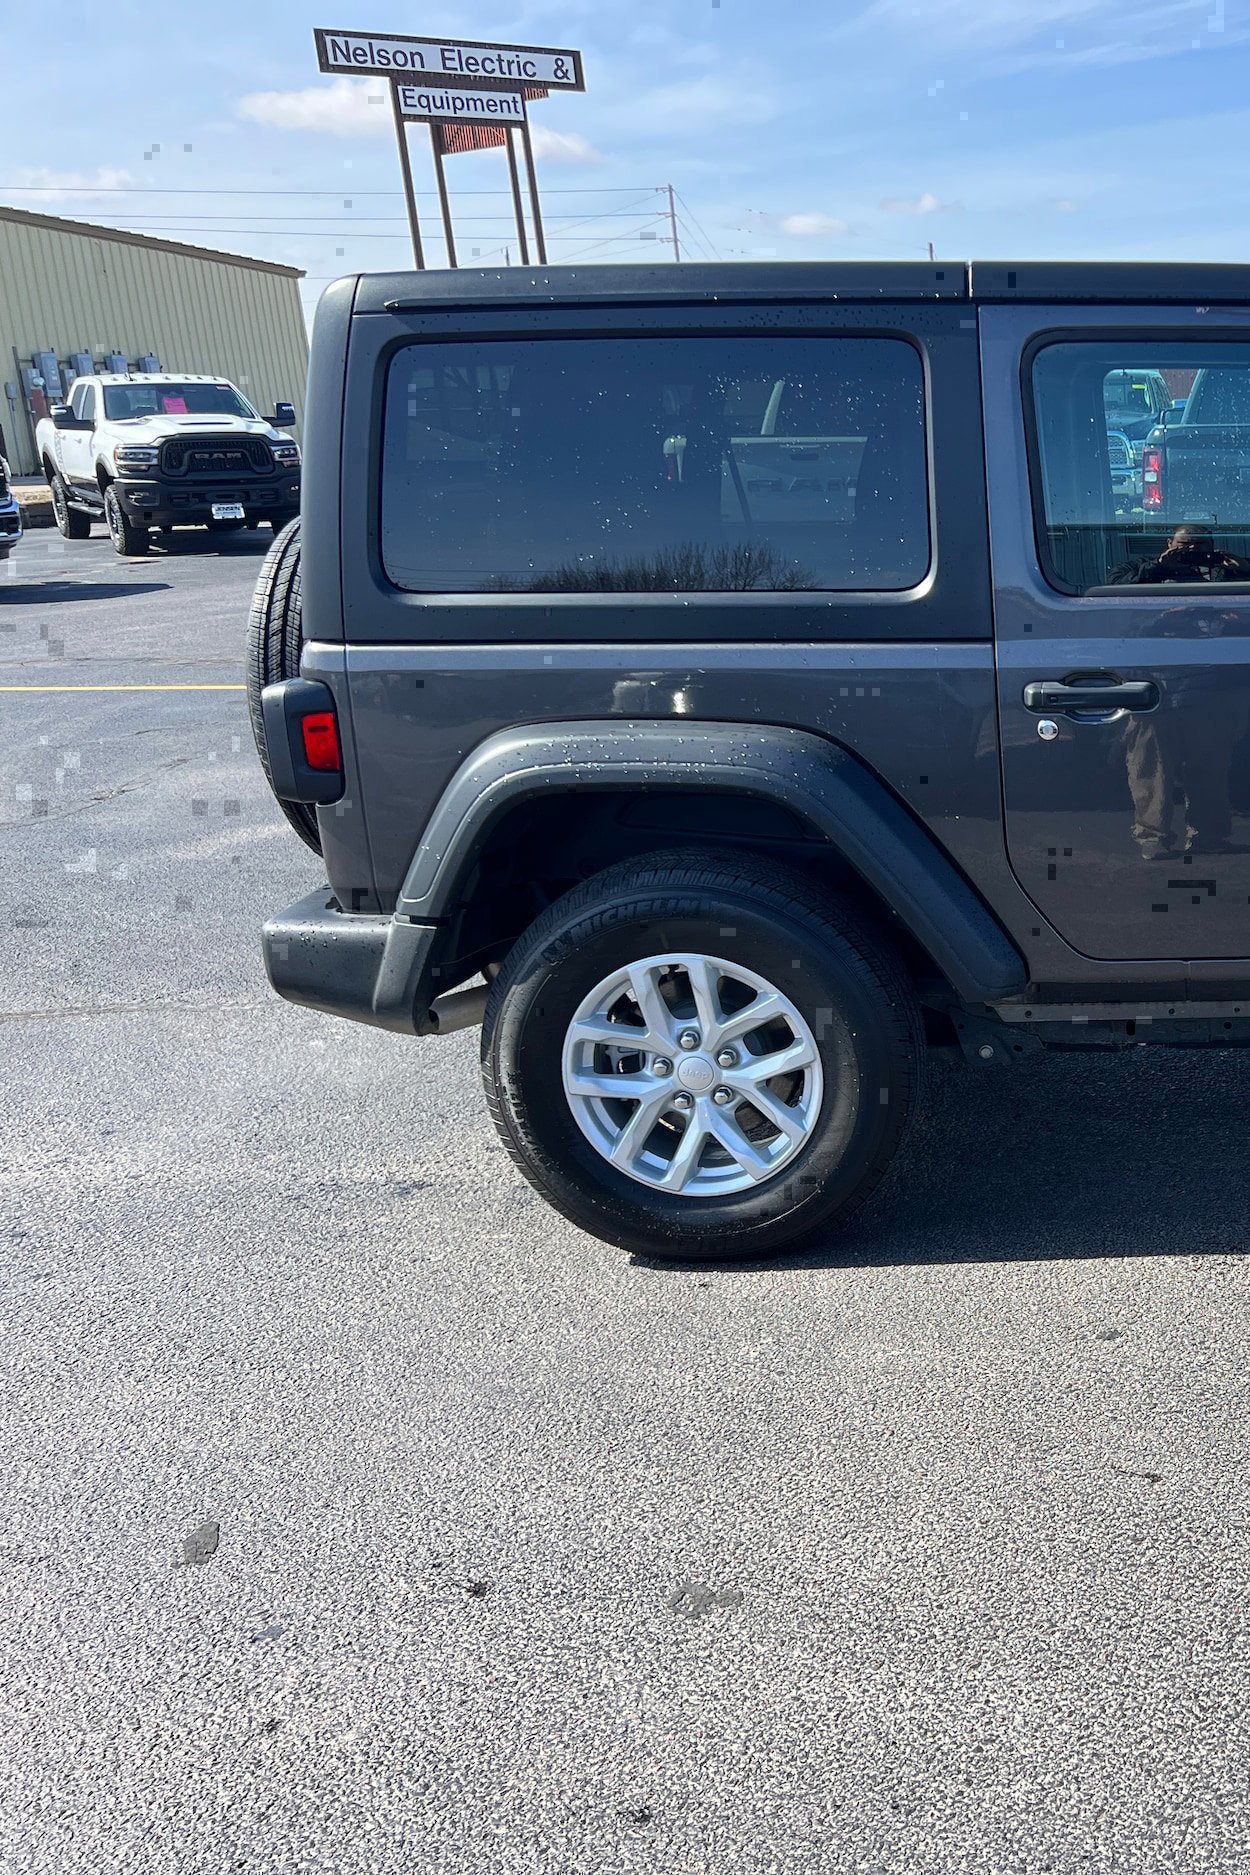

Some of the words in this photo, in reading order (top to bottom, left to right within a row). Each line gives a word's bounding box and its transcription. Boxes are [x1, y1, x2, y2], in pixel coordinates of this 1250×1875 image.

[331, 39, 425, 69] Nelson
[440, 48, 537, 78] Electric
[553, 57, 571, 80] &
[402, 88, 520, 115] Equipment
[570, 898, 702, 943] MICHELIN
[681, 1067, 711, 1081] Jeep
